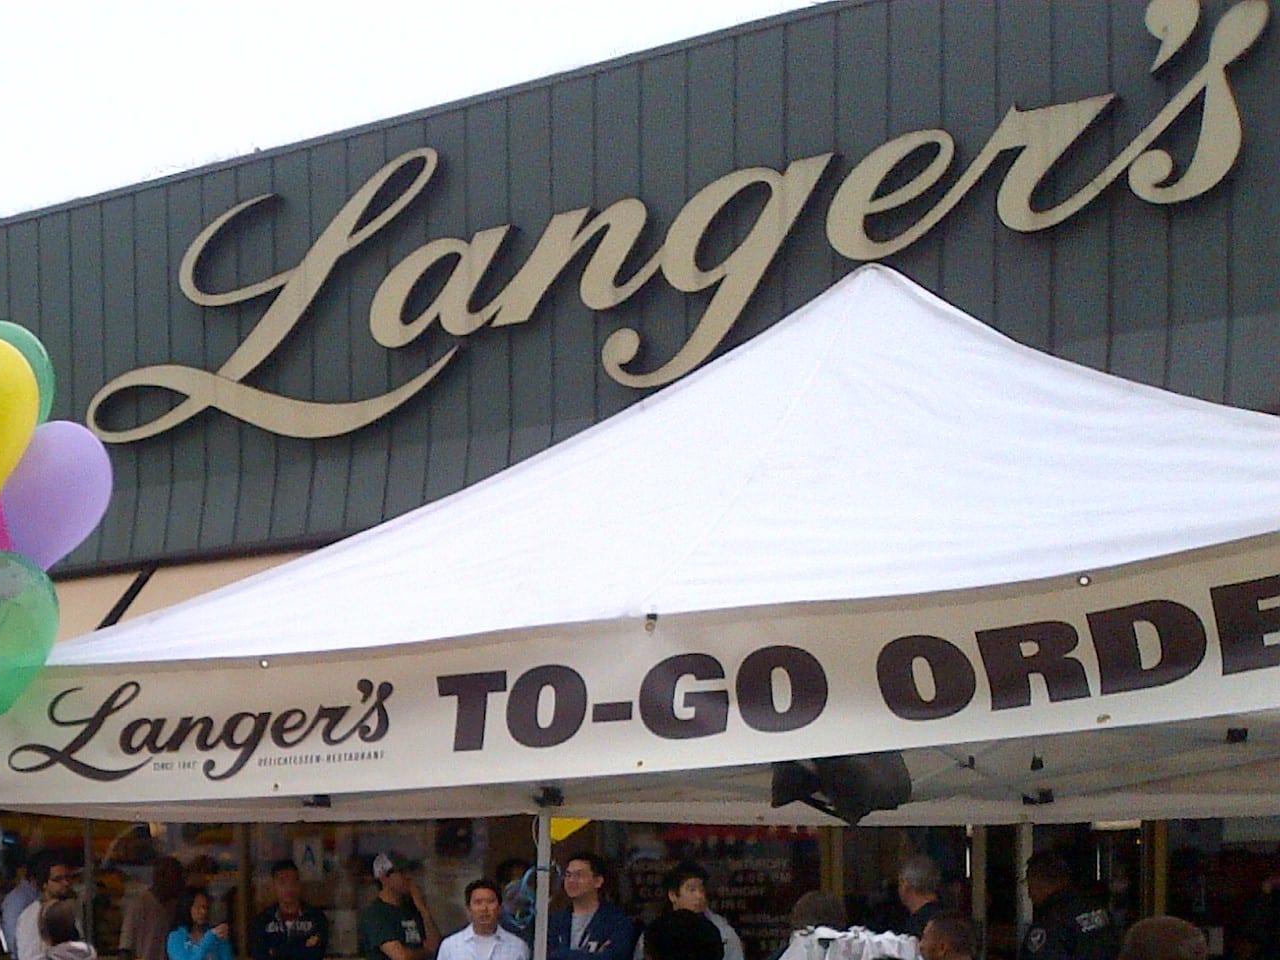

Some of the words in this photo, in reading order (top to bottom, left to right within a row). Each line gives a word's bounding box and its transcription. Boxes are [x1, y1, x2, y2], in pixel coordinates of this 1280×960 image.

[87, 0, 1270, 443] Langer's
[7, 679, 394, 782] Langer's
[436, 644, 828, 752] TO-GO
[876, 575, 1280, 722] ORDE
